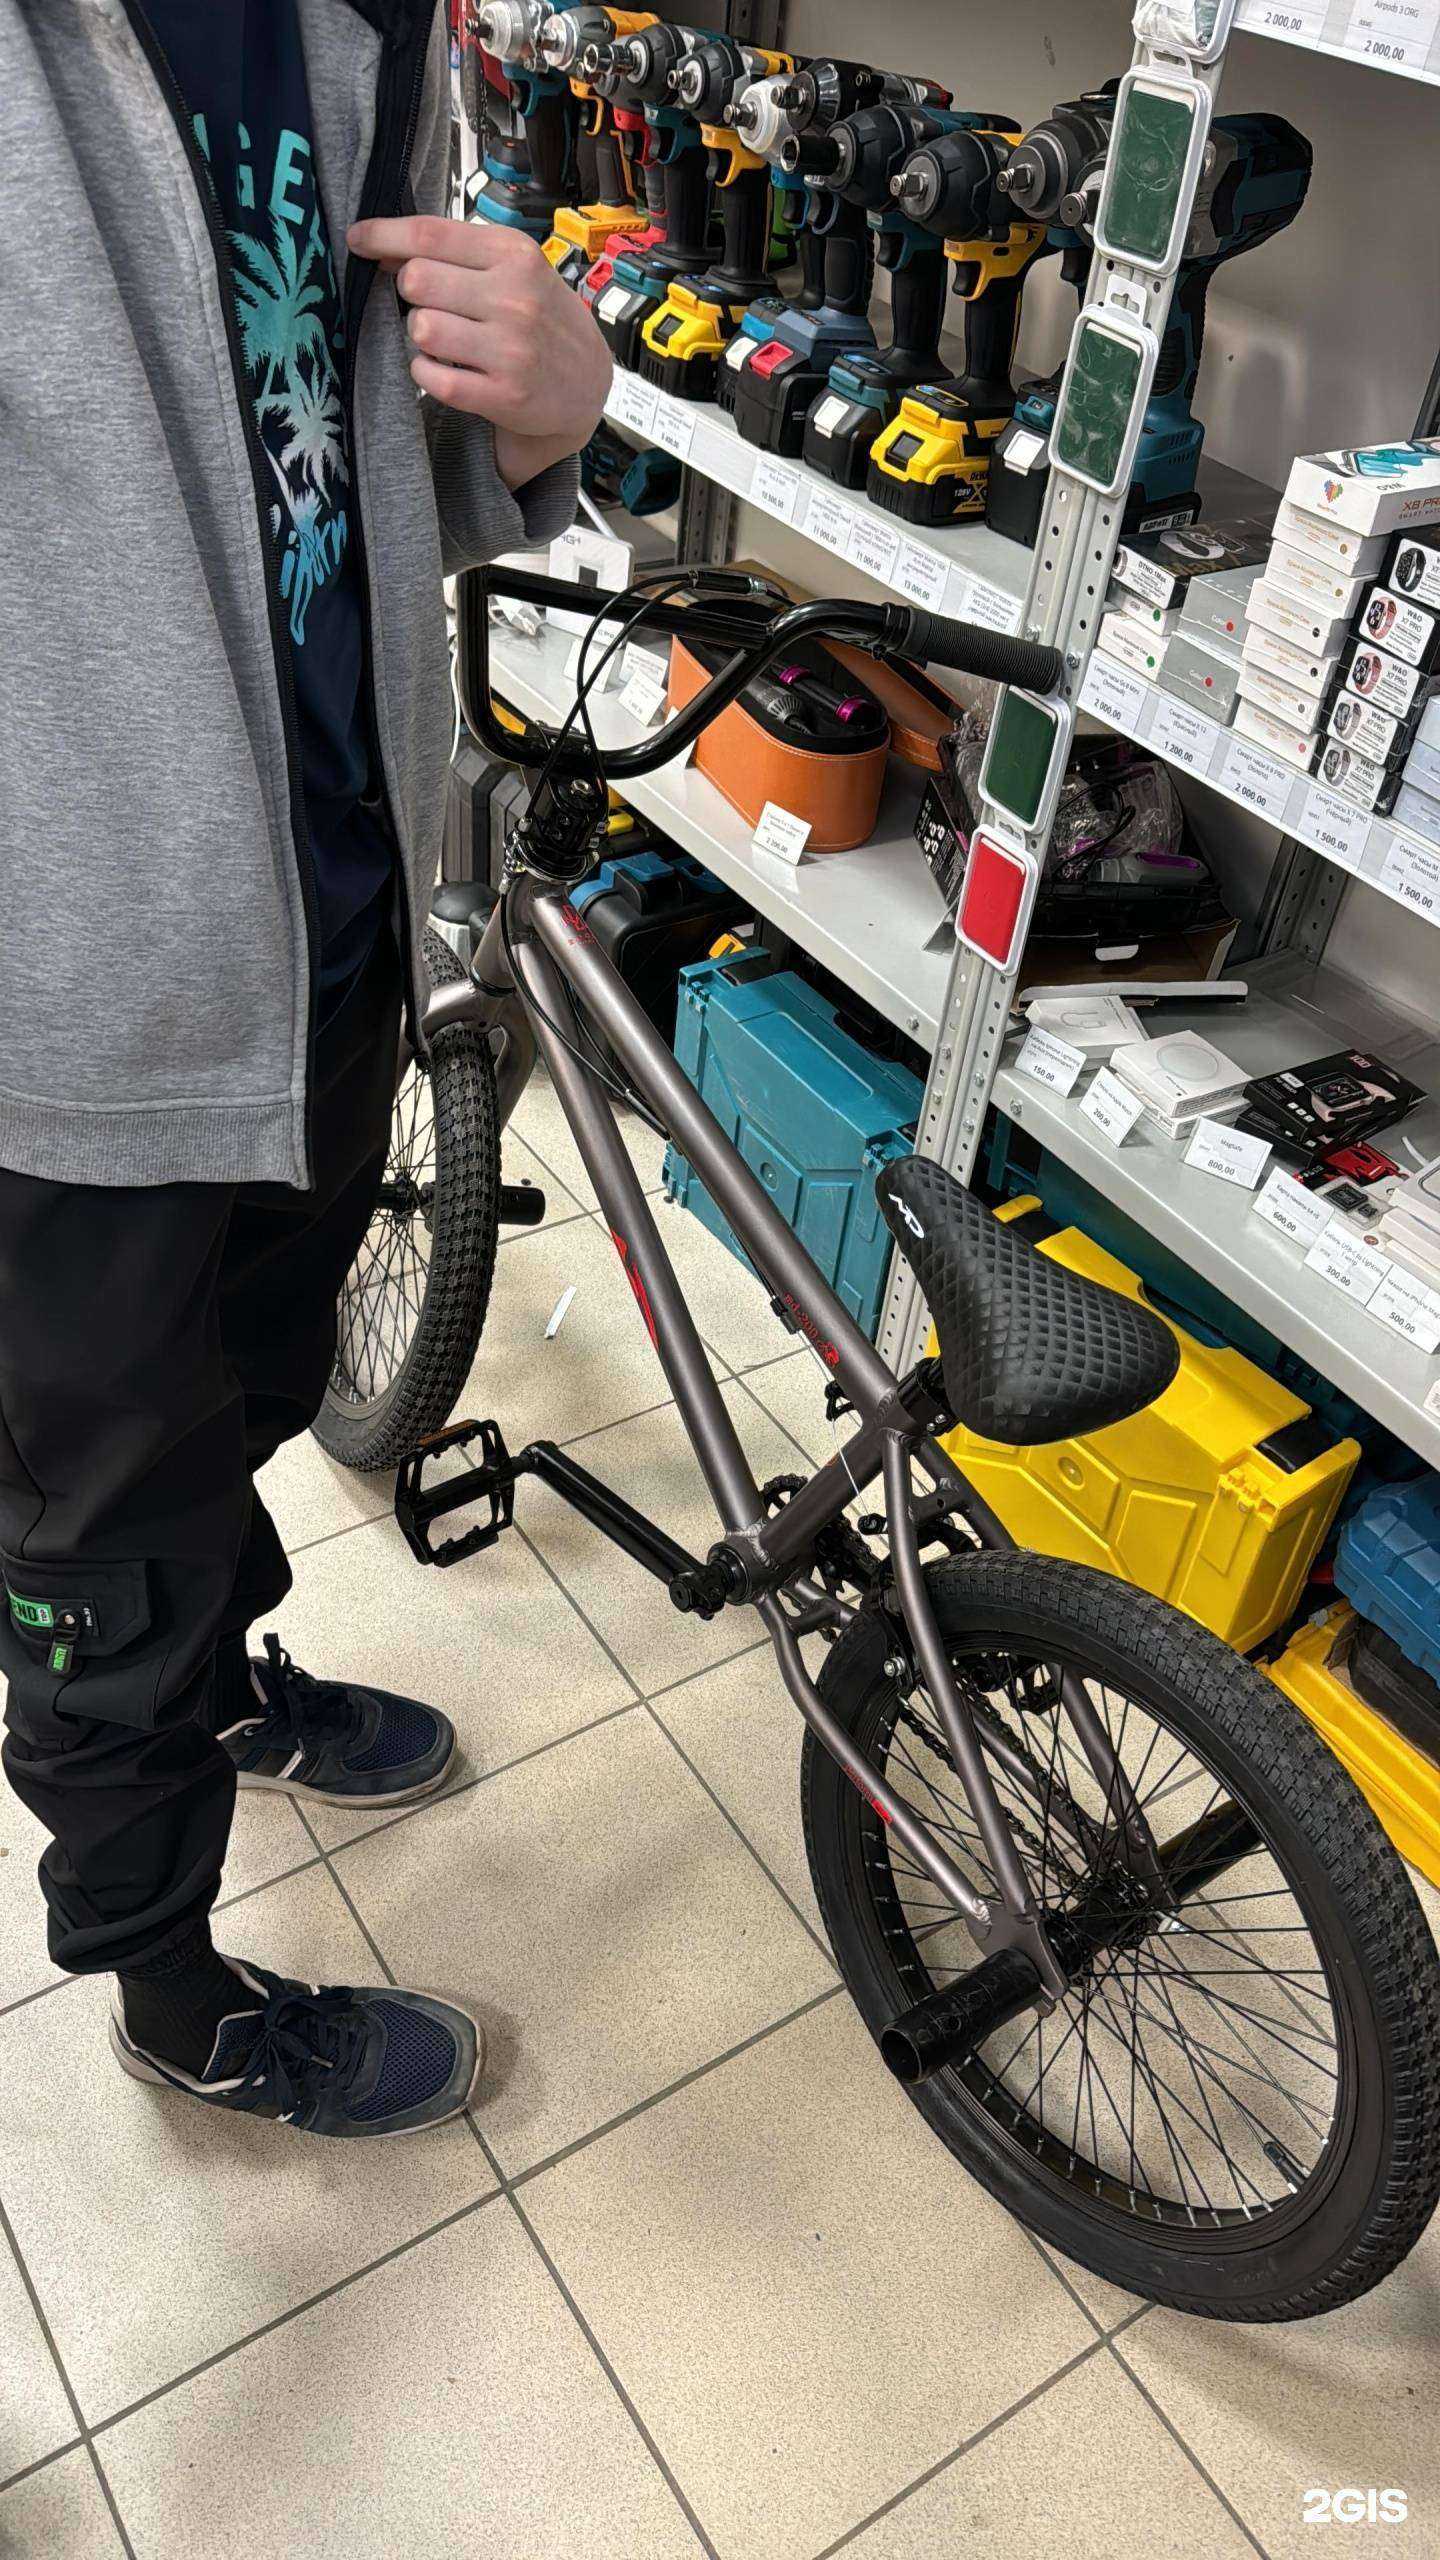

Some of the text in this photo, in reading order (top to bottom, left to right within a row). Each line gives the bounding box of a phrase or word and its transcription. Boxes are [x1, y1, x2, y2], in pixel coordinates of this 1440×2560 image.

[1273, 14, 1302, 31] 000,00
[1373, 42, 1404, 61] 000,00
[1100, 701, 1121, 720] 000,00
[1169, 743, 1194, 763] 200,00
[1241, 786, 1266, 807] 000,00
[1320, 831, 1348, 853] 500,00
[1404, 886, 1433, 909] 500,00
[1033, 1065, 1055, 1082] 150,00
[1093, 1108, 1111, 1127] 200,00
[1207, 1159, 1235, 1176] 800,00
[1273, 1211, 1297, 1232] 600,00
[1326, 1265, 1351, 1287] 300,00
[1389, 1311, 1416, 1334] 500,00
